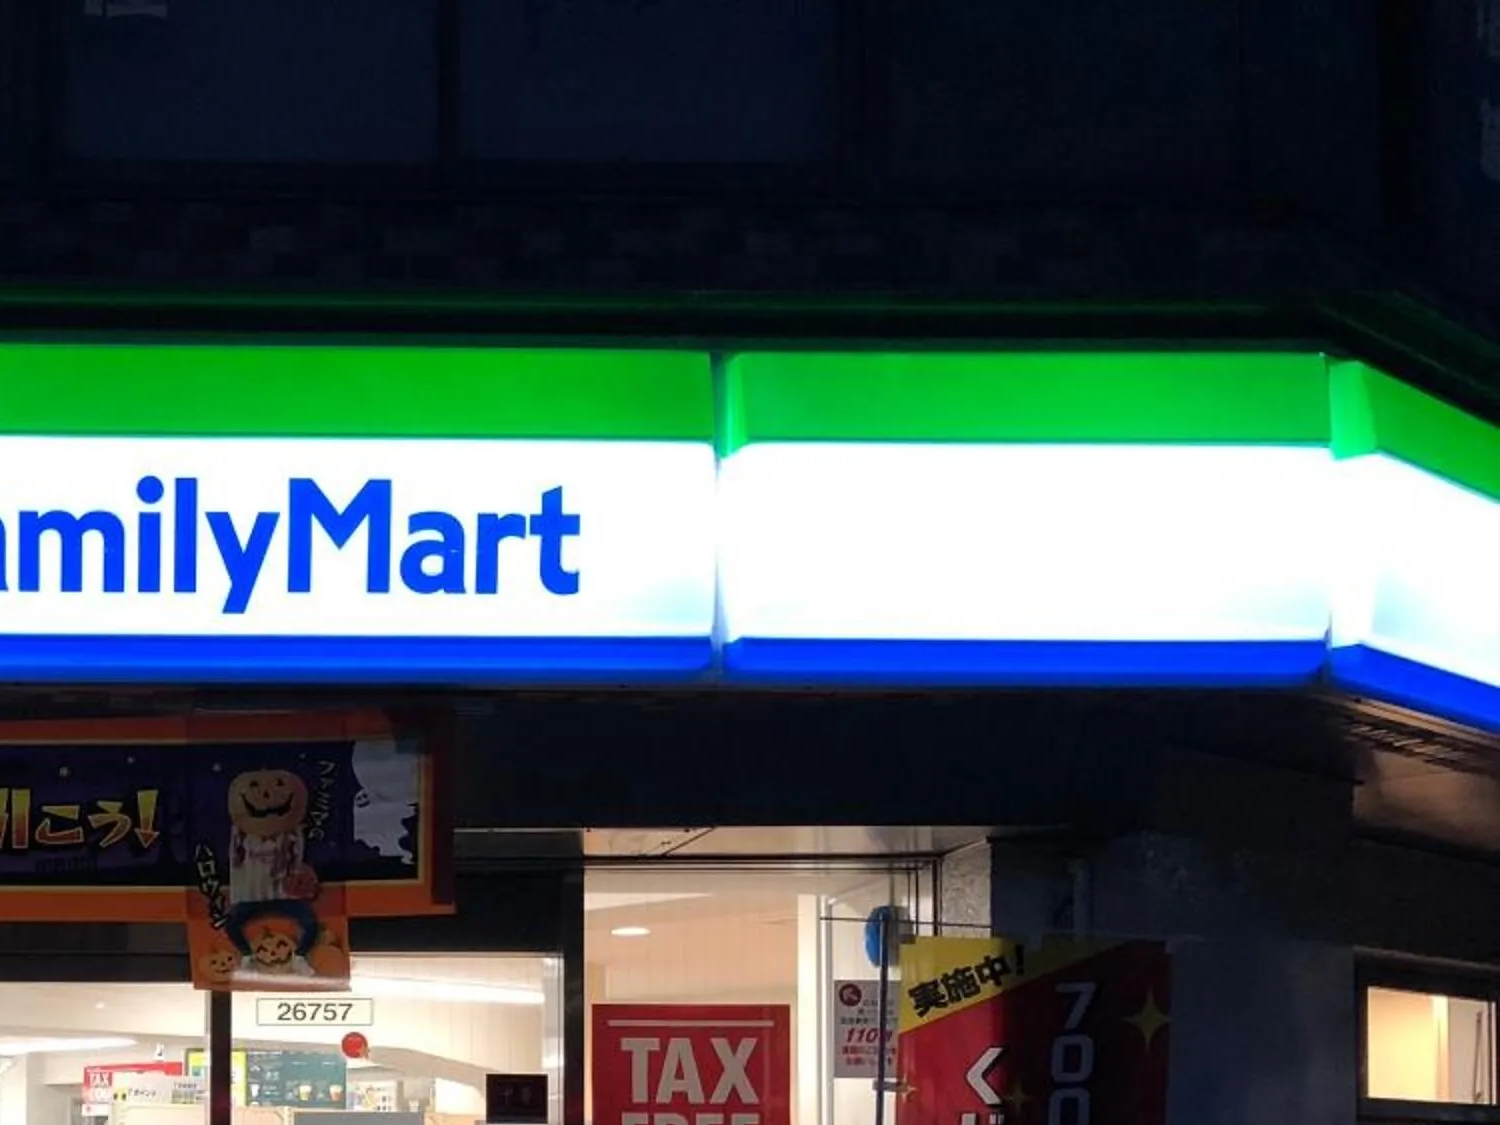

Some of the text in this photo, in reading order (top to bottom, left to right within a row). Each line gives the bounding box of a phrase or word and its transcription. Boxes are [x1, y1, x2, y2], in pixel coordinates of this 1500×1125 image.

[277, 1002, 353, 1021] 26757
[907, 943, 1029, 1019] 実施中!
[620, 1037, 760, 1105] TAX
